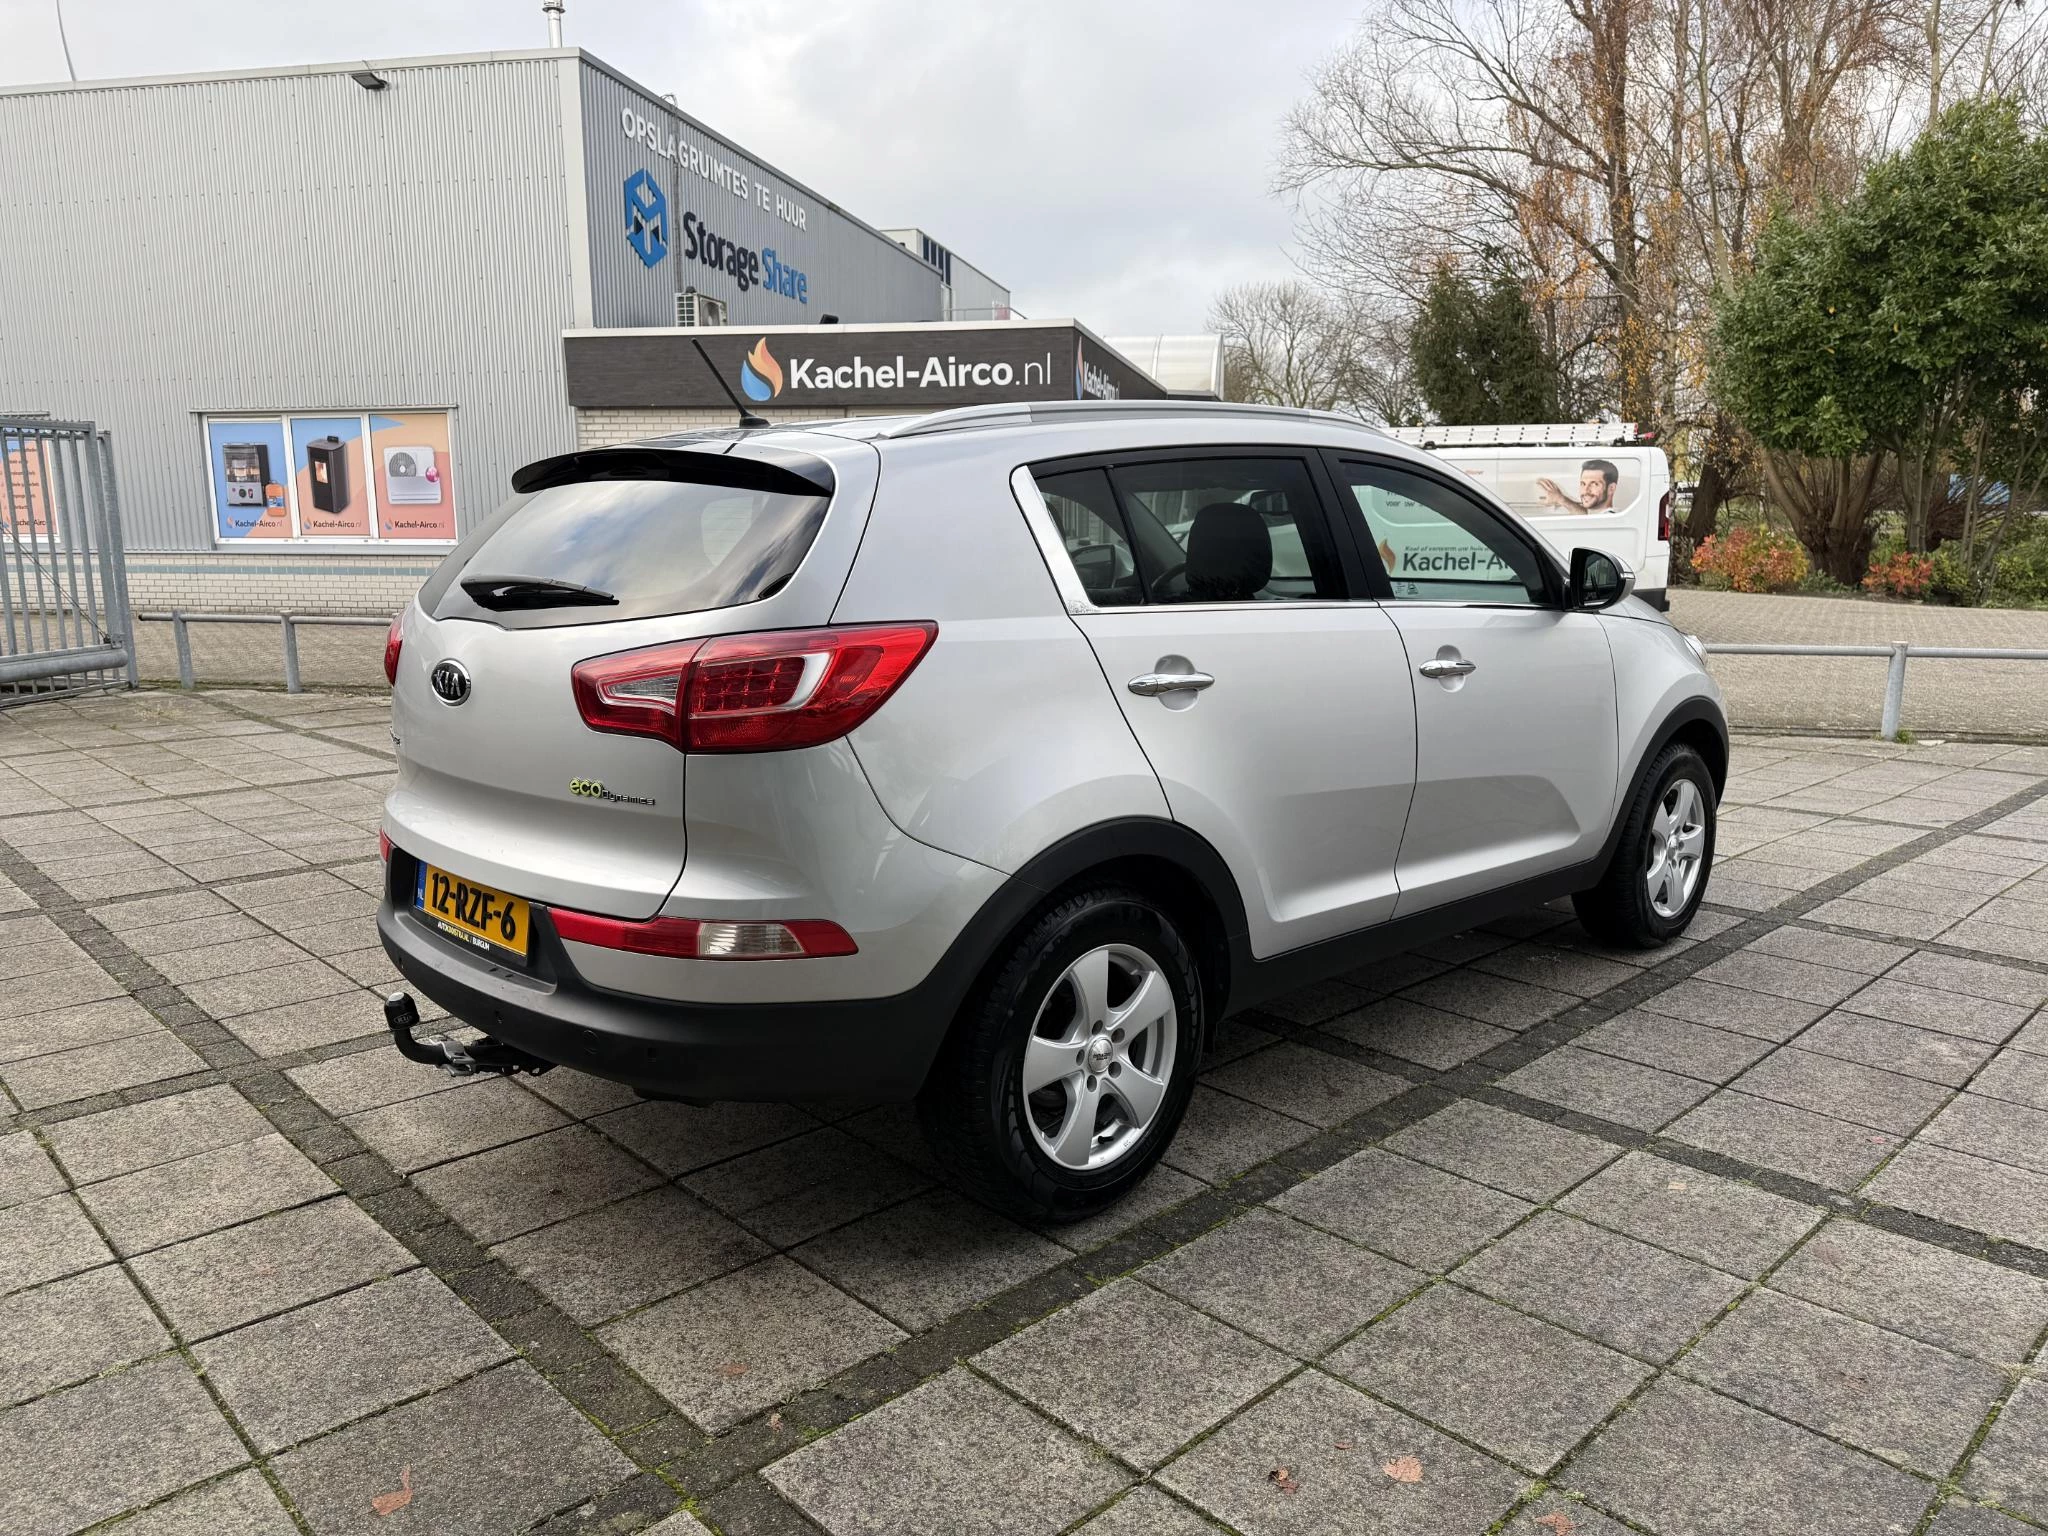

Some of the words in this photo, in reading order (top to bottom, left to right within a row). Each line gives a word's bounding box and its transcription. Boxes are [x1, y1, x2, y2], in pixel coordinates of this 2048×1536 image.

[621, 107, 748, 200] OPSLAGRUIMTES
[754, 183, 771, 212] TE
[776, 196, 807, 231] HUUR
[683, 211, 759, 292] Storage
[762, 247, 808, 304] Share
[790, 351, 1051, 390] Kachel-Airco.nl
[434, 669, 461, 697] KIA
[417, 887, 424, 901] NL
[431, 872, 516, 941] 12-RZF-6
[472, 936, 490, 951] BURGUM
